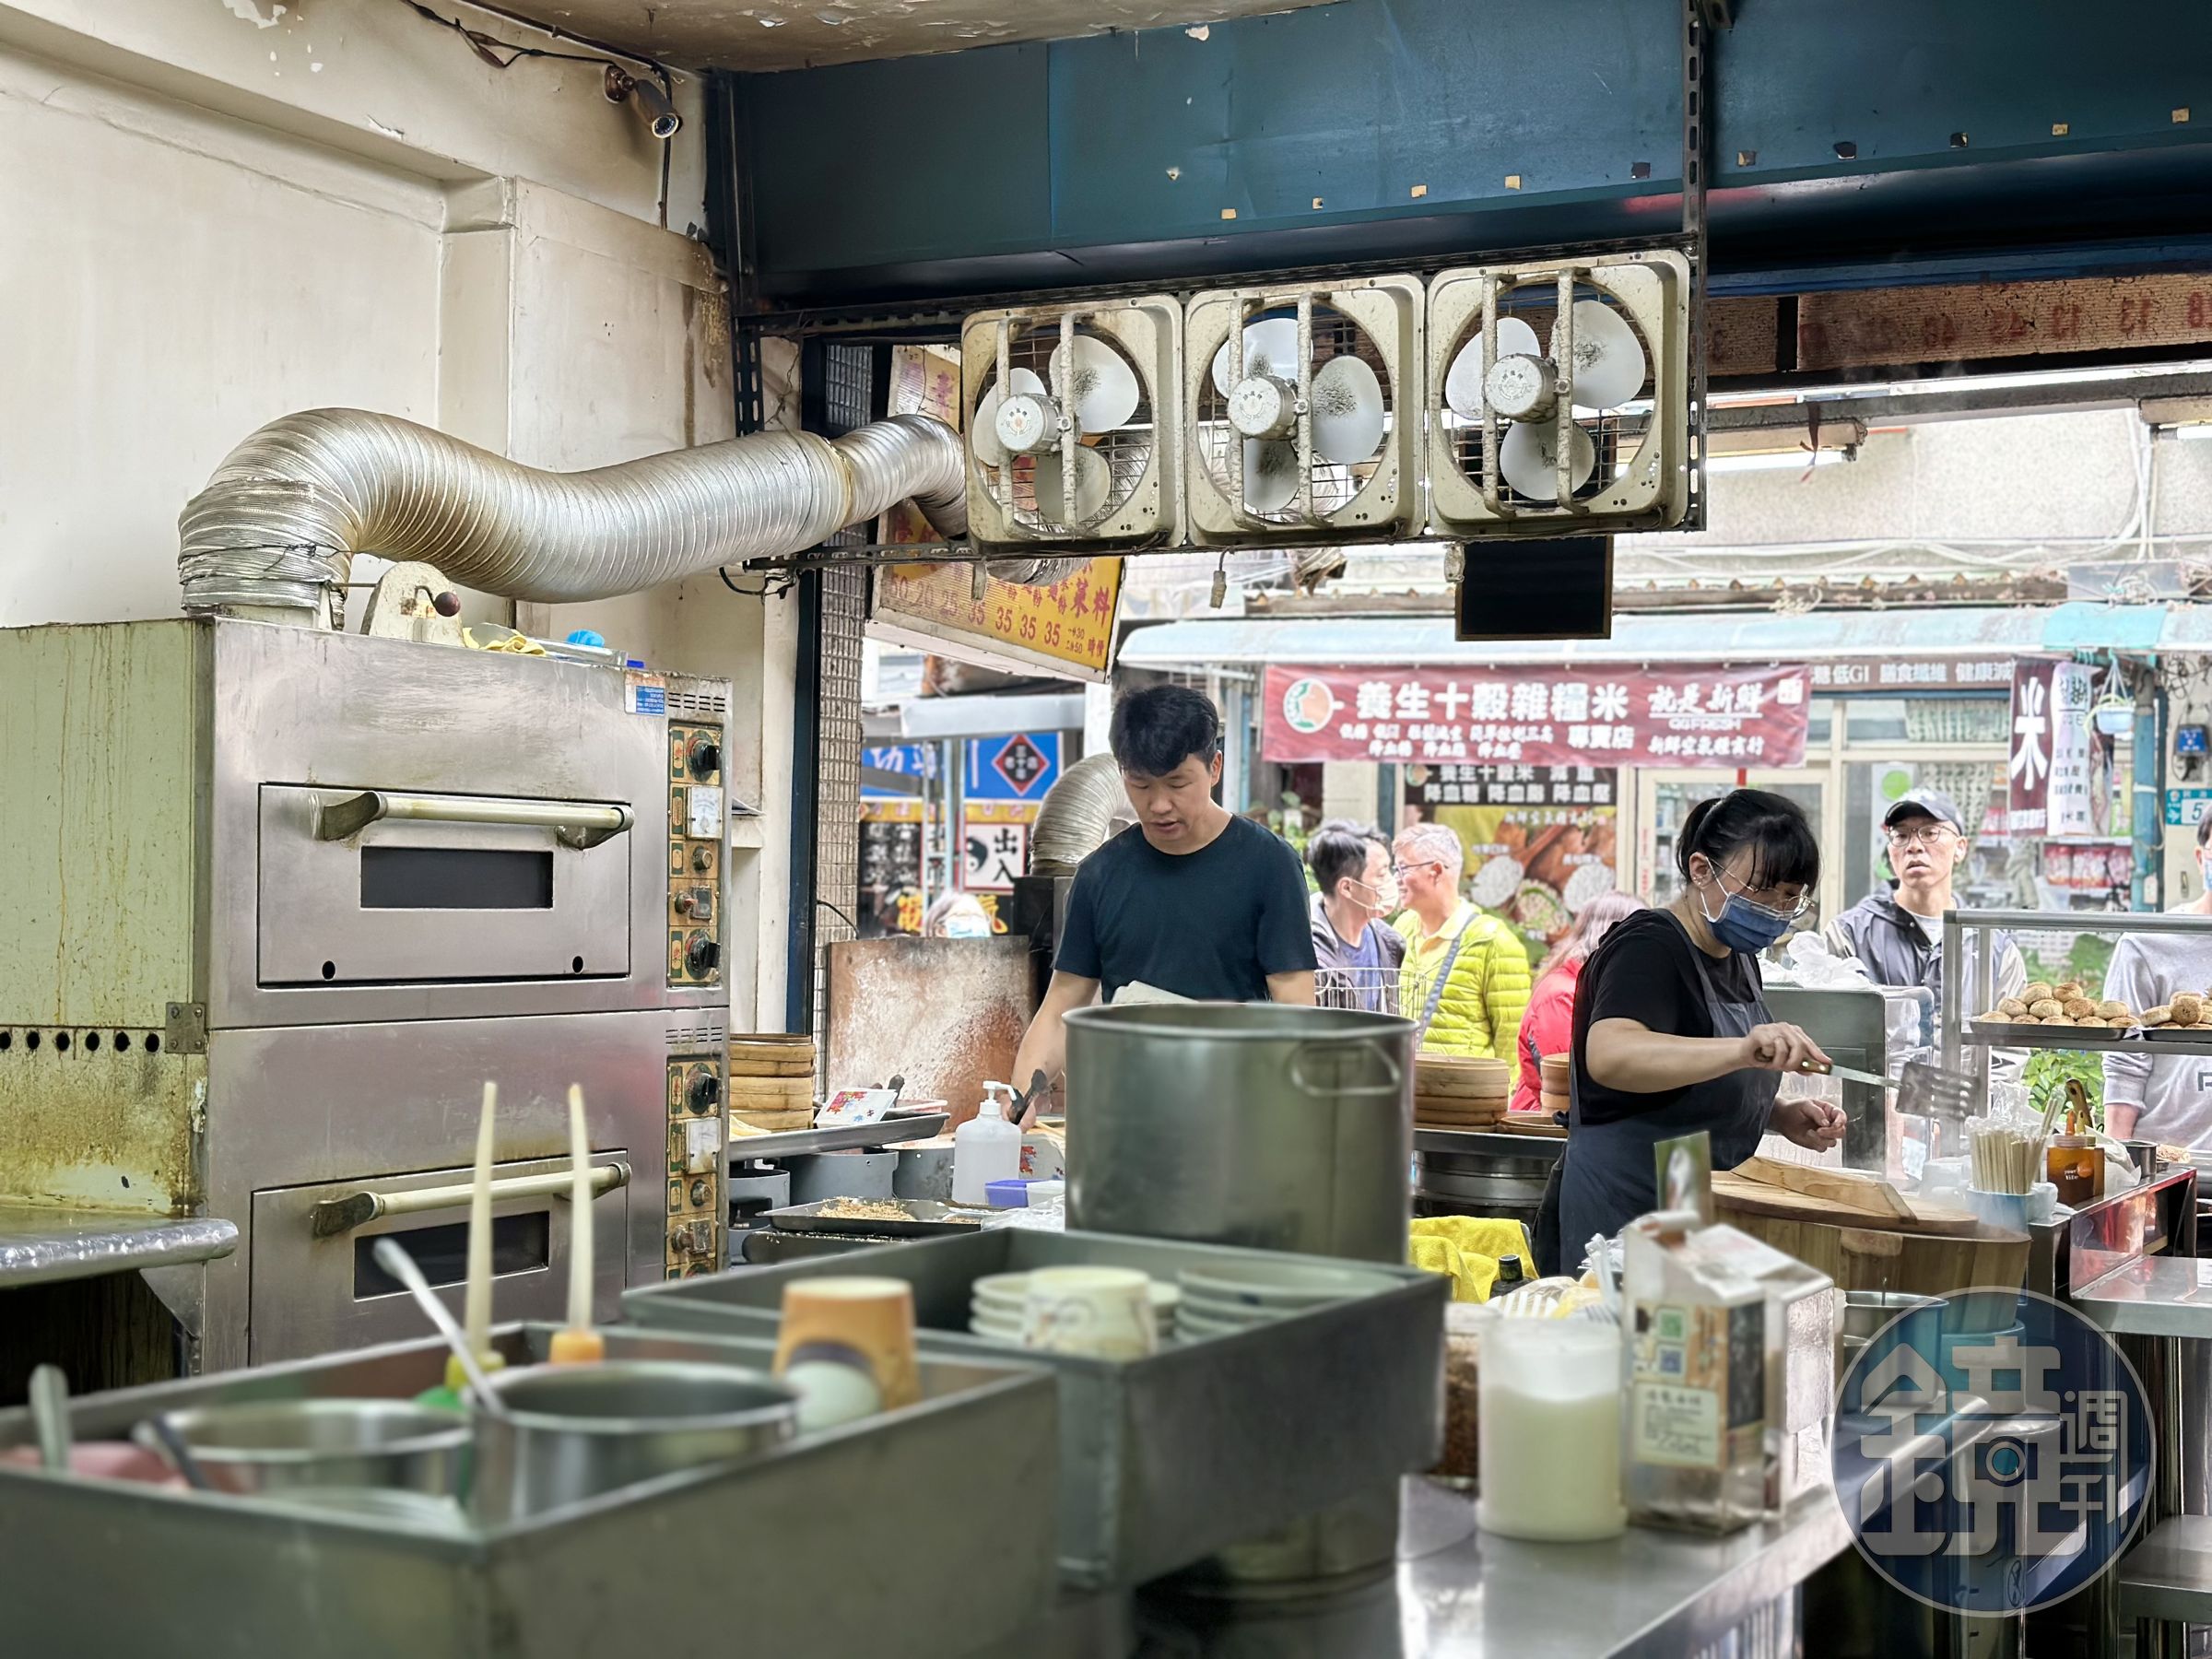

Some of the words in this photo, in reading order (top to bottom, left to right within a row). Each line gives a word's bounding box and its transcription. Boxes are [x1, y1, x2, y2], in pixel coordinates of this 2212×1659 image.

[968, 600, 985, 626] 35
[995, 606, 1012, 633] 35
[1019, 614, 1037, 640] 35
[1044, 621, 1061, 647] 35
[2010, 677, 2048, 791] 米
